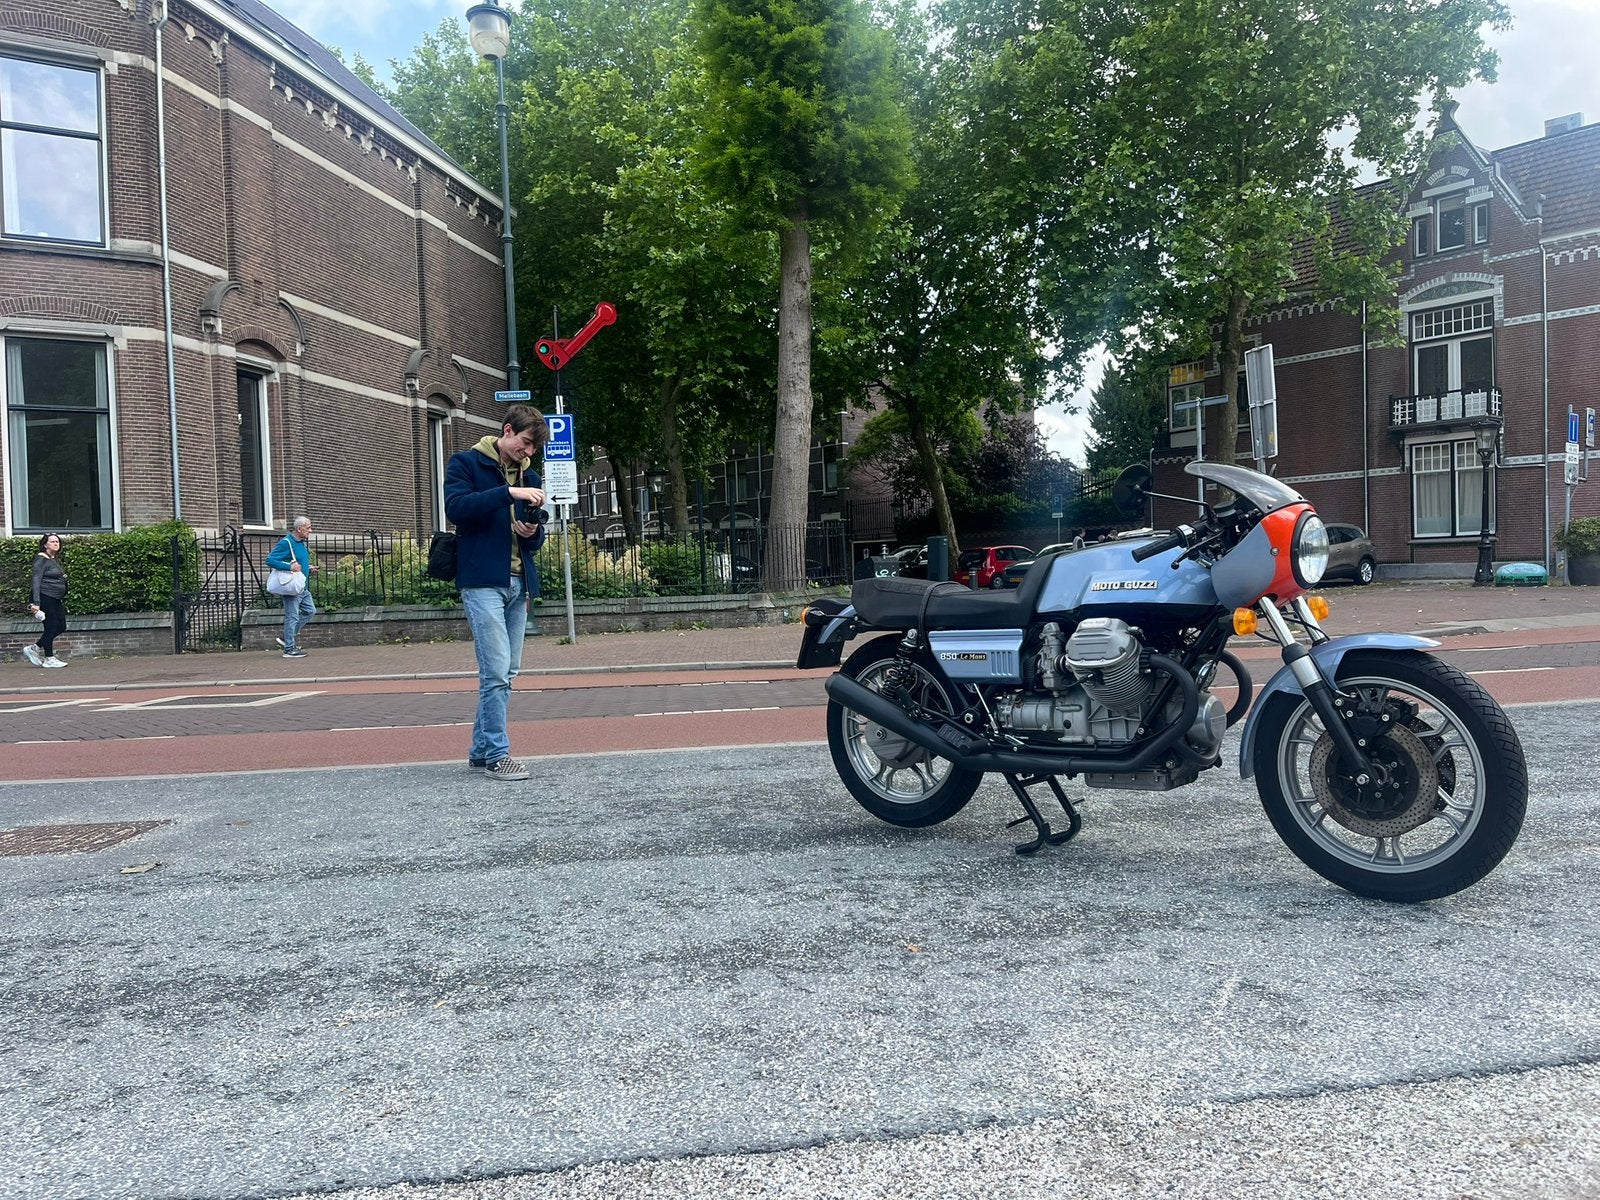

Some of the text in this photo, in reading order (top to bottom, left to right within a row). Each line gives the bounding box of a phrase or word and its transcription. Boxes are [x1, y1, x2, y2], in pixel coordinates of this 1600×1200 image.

[549, 418, 566, 441] P
[1091, 580, 1157, 591] MOTO GUZZI
[940, 652, 957, 660] 850
